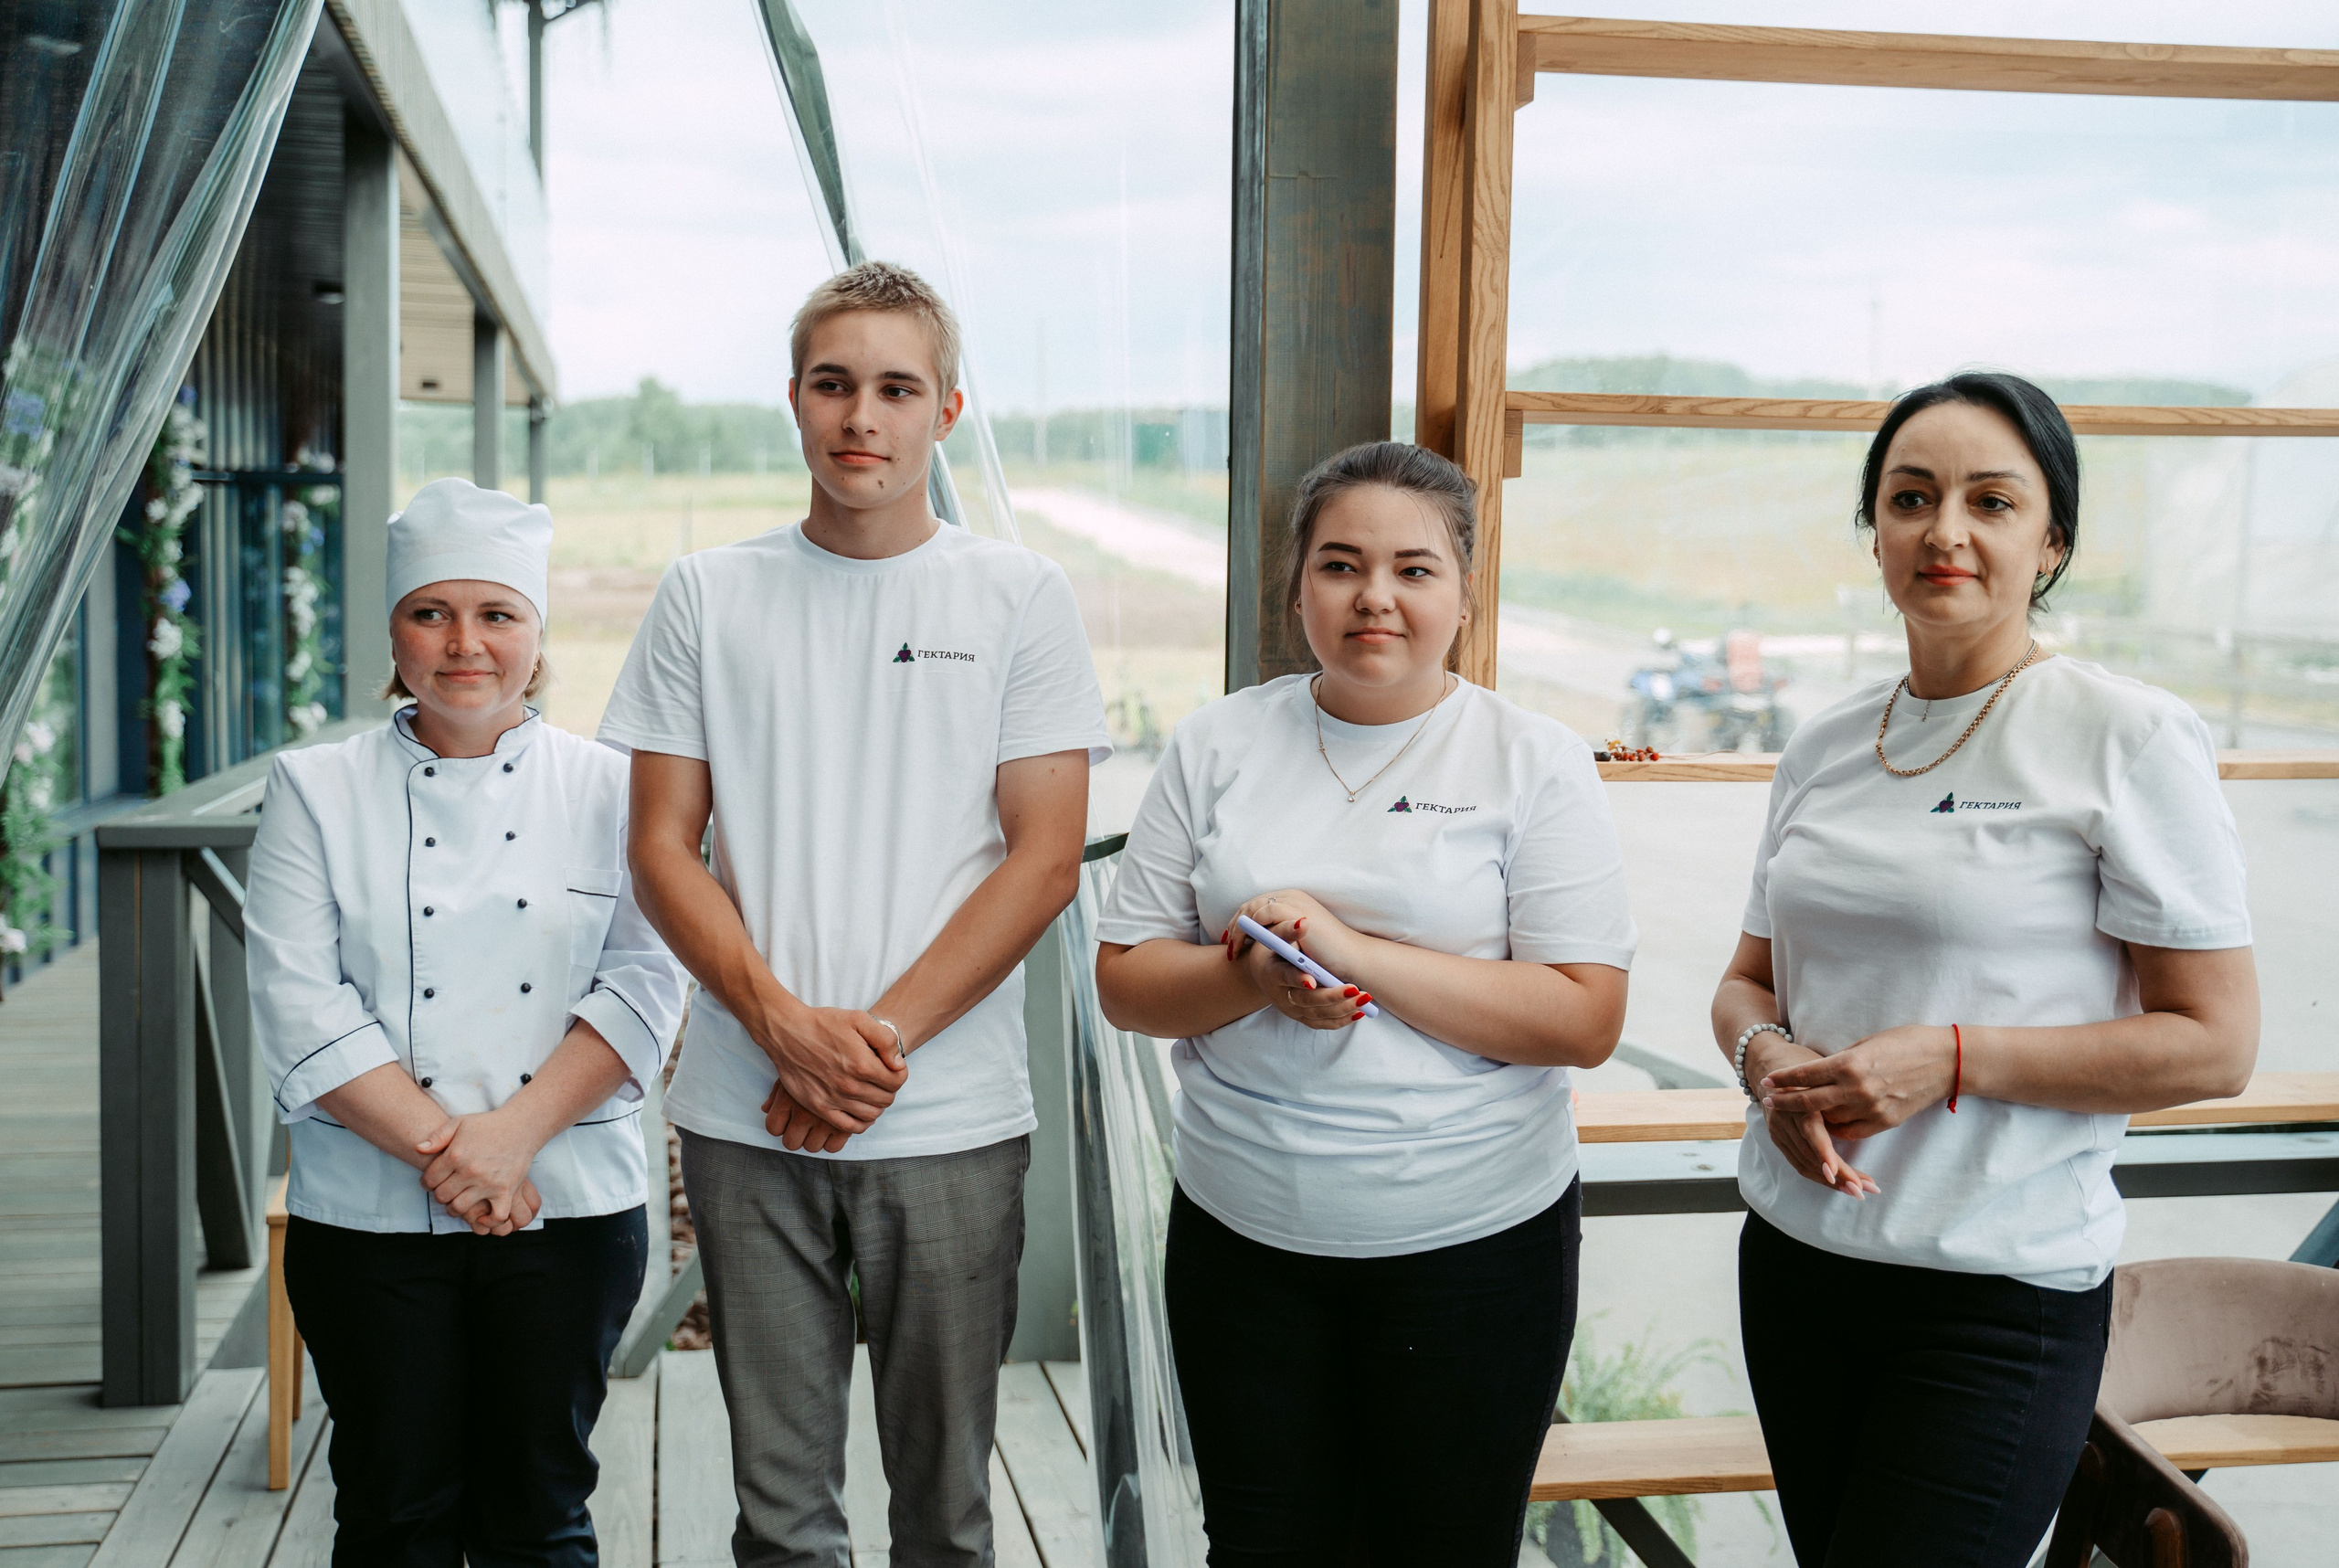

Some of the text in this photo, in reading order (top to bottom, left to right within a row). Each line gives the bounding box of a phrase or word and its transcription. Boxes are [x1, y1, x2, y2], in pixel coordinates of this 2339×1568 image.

[917, 649, 976, 662] ГЕКТАРИЯ
[1414, 802, 1477, 814] ГЕКТАРИЯ
[1958, 800, 2022, 810] ГЕКТАРИЯ
